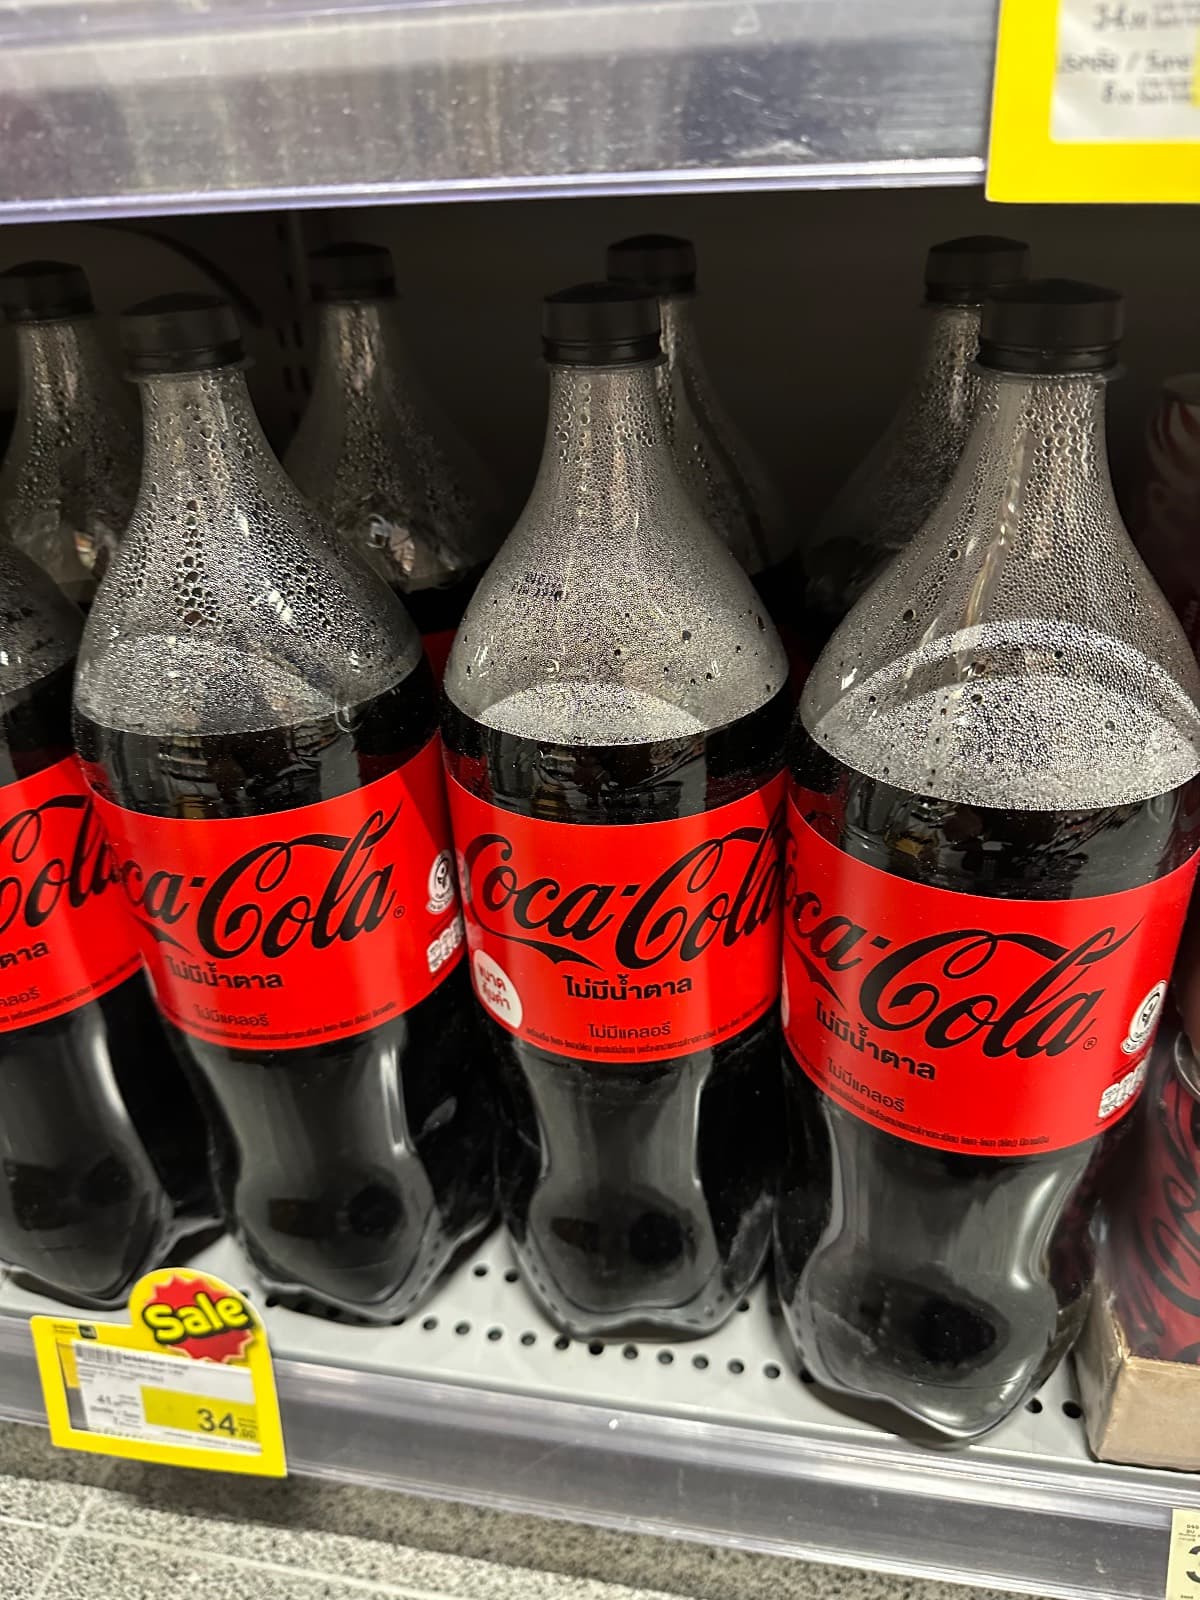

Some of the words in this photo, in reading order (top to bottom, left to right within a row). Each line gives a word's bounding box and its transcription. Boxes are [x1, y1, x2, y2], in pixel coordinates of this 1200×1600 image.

[118, 798, 404, 960] ca-Cola
[166, 956, 284, 989] ไม่มีน้ำตาล
[563, 973, 692, 1001] ไม่มีน้ำตาล
[588, 1021, 671, 1040] ไม่มีแคลอรี
[814, 999, 937, 1082] ไม่มีน้ำตาล
[826, 1055, 906, 1113] ไม่มีแคลอรี
[142, 1290, 254, 1345] Sale
[197, 1407, 236, 1437] 34
